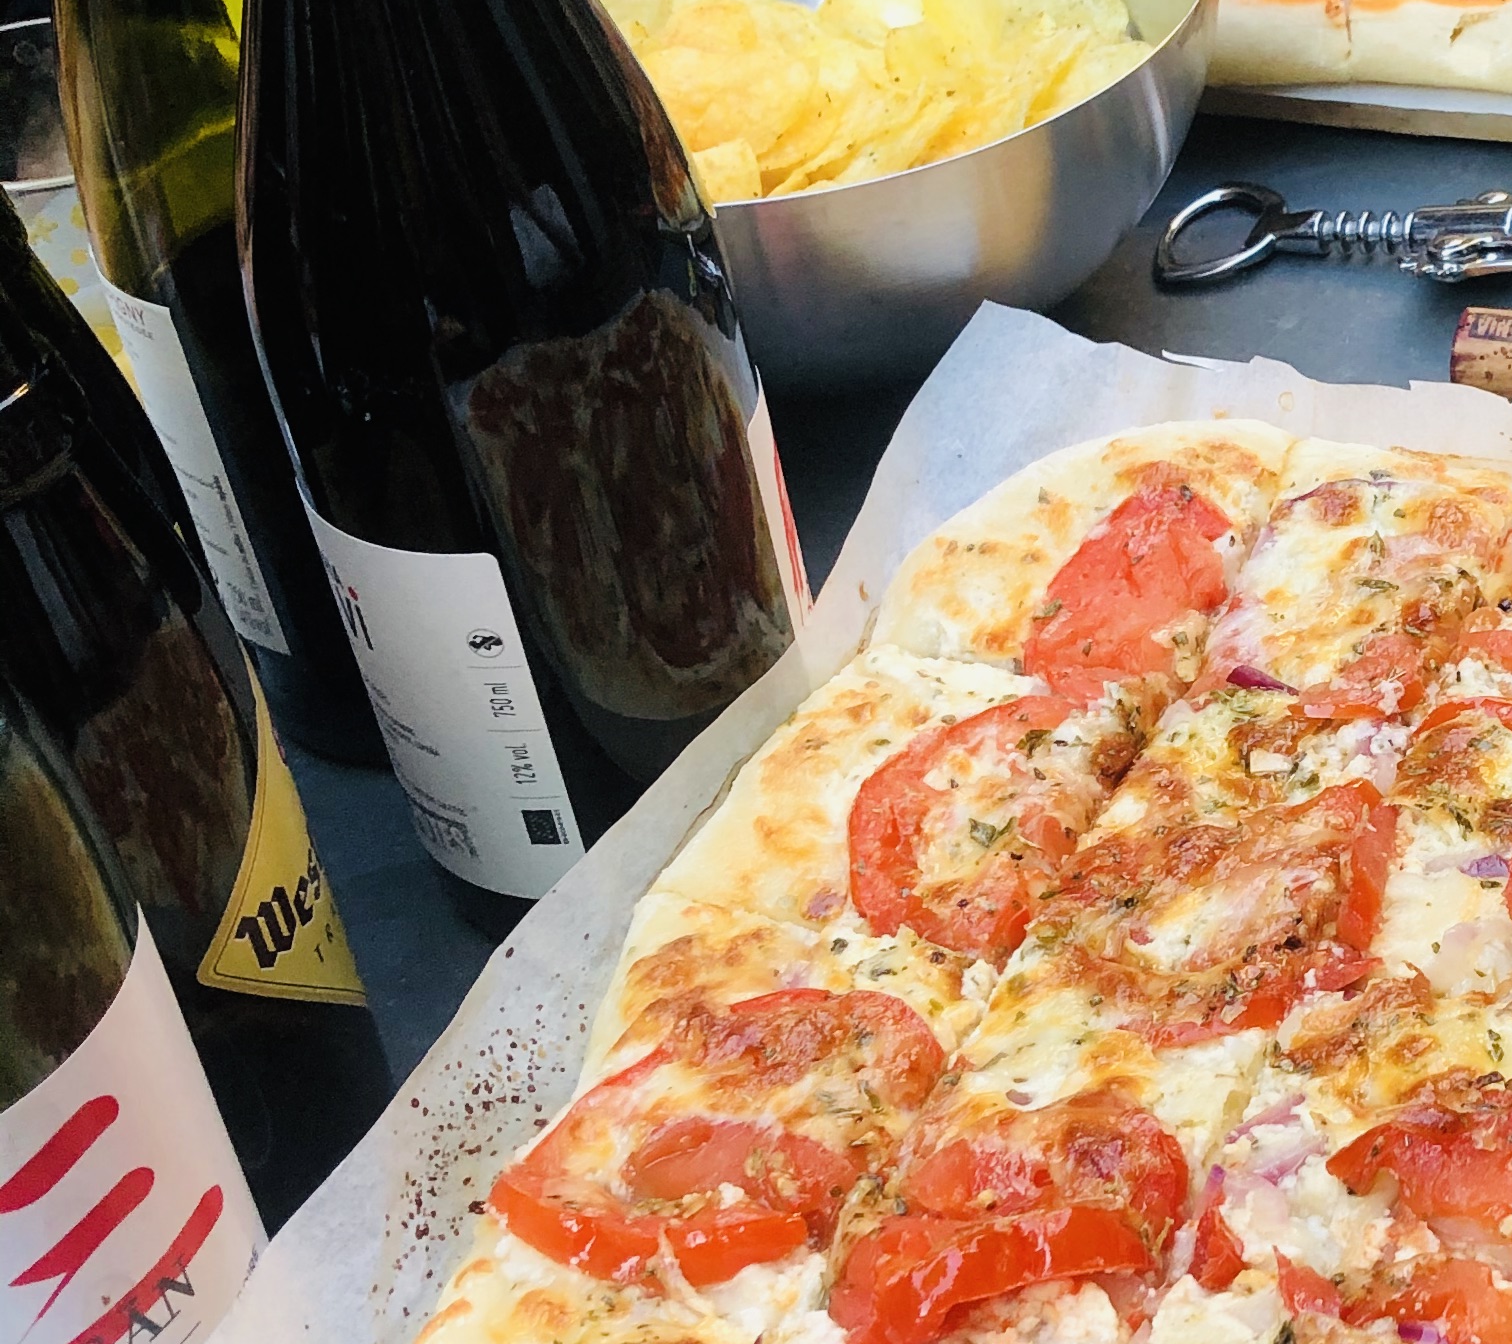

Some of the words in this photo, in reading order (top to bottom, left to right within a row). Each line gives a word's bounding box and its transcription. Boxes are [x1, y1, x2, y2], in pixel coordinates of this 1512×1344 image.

[484, 681, 509, 696] ml
[489, 696, 517, 718] 750
[510, 762, 537, 785] 12%
